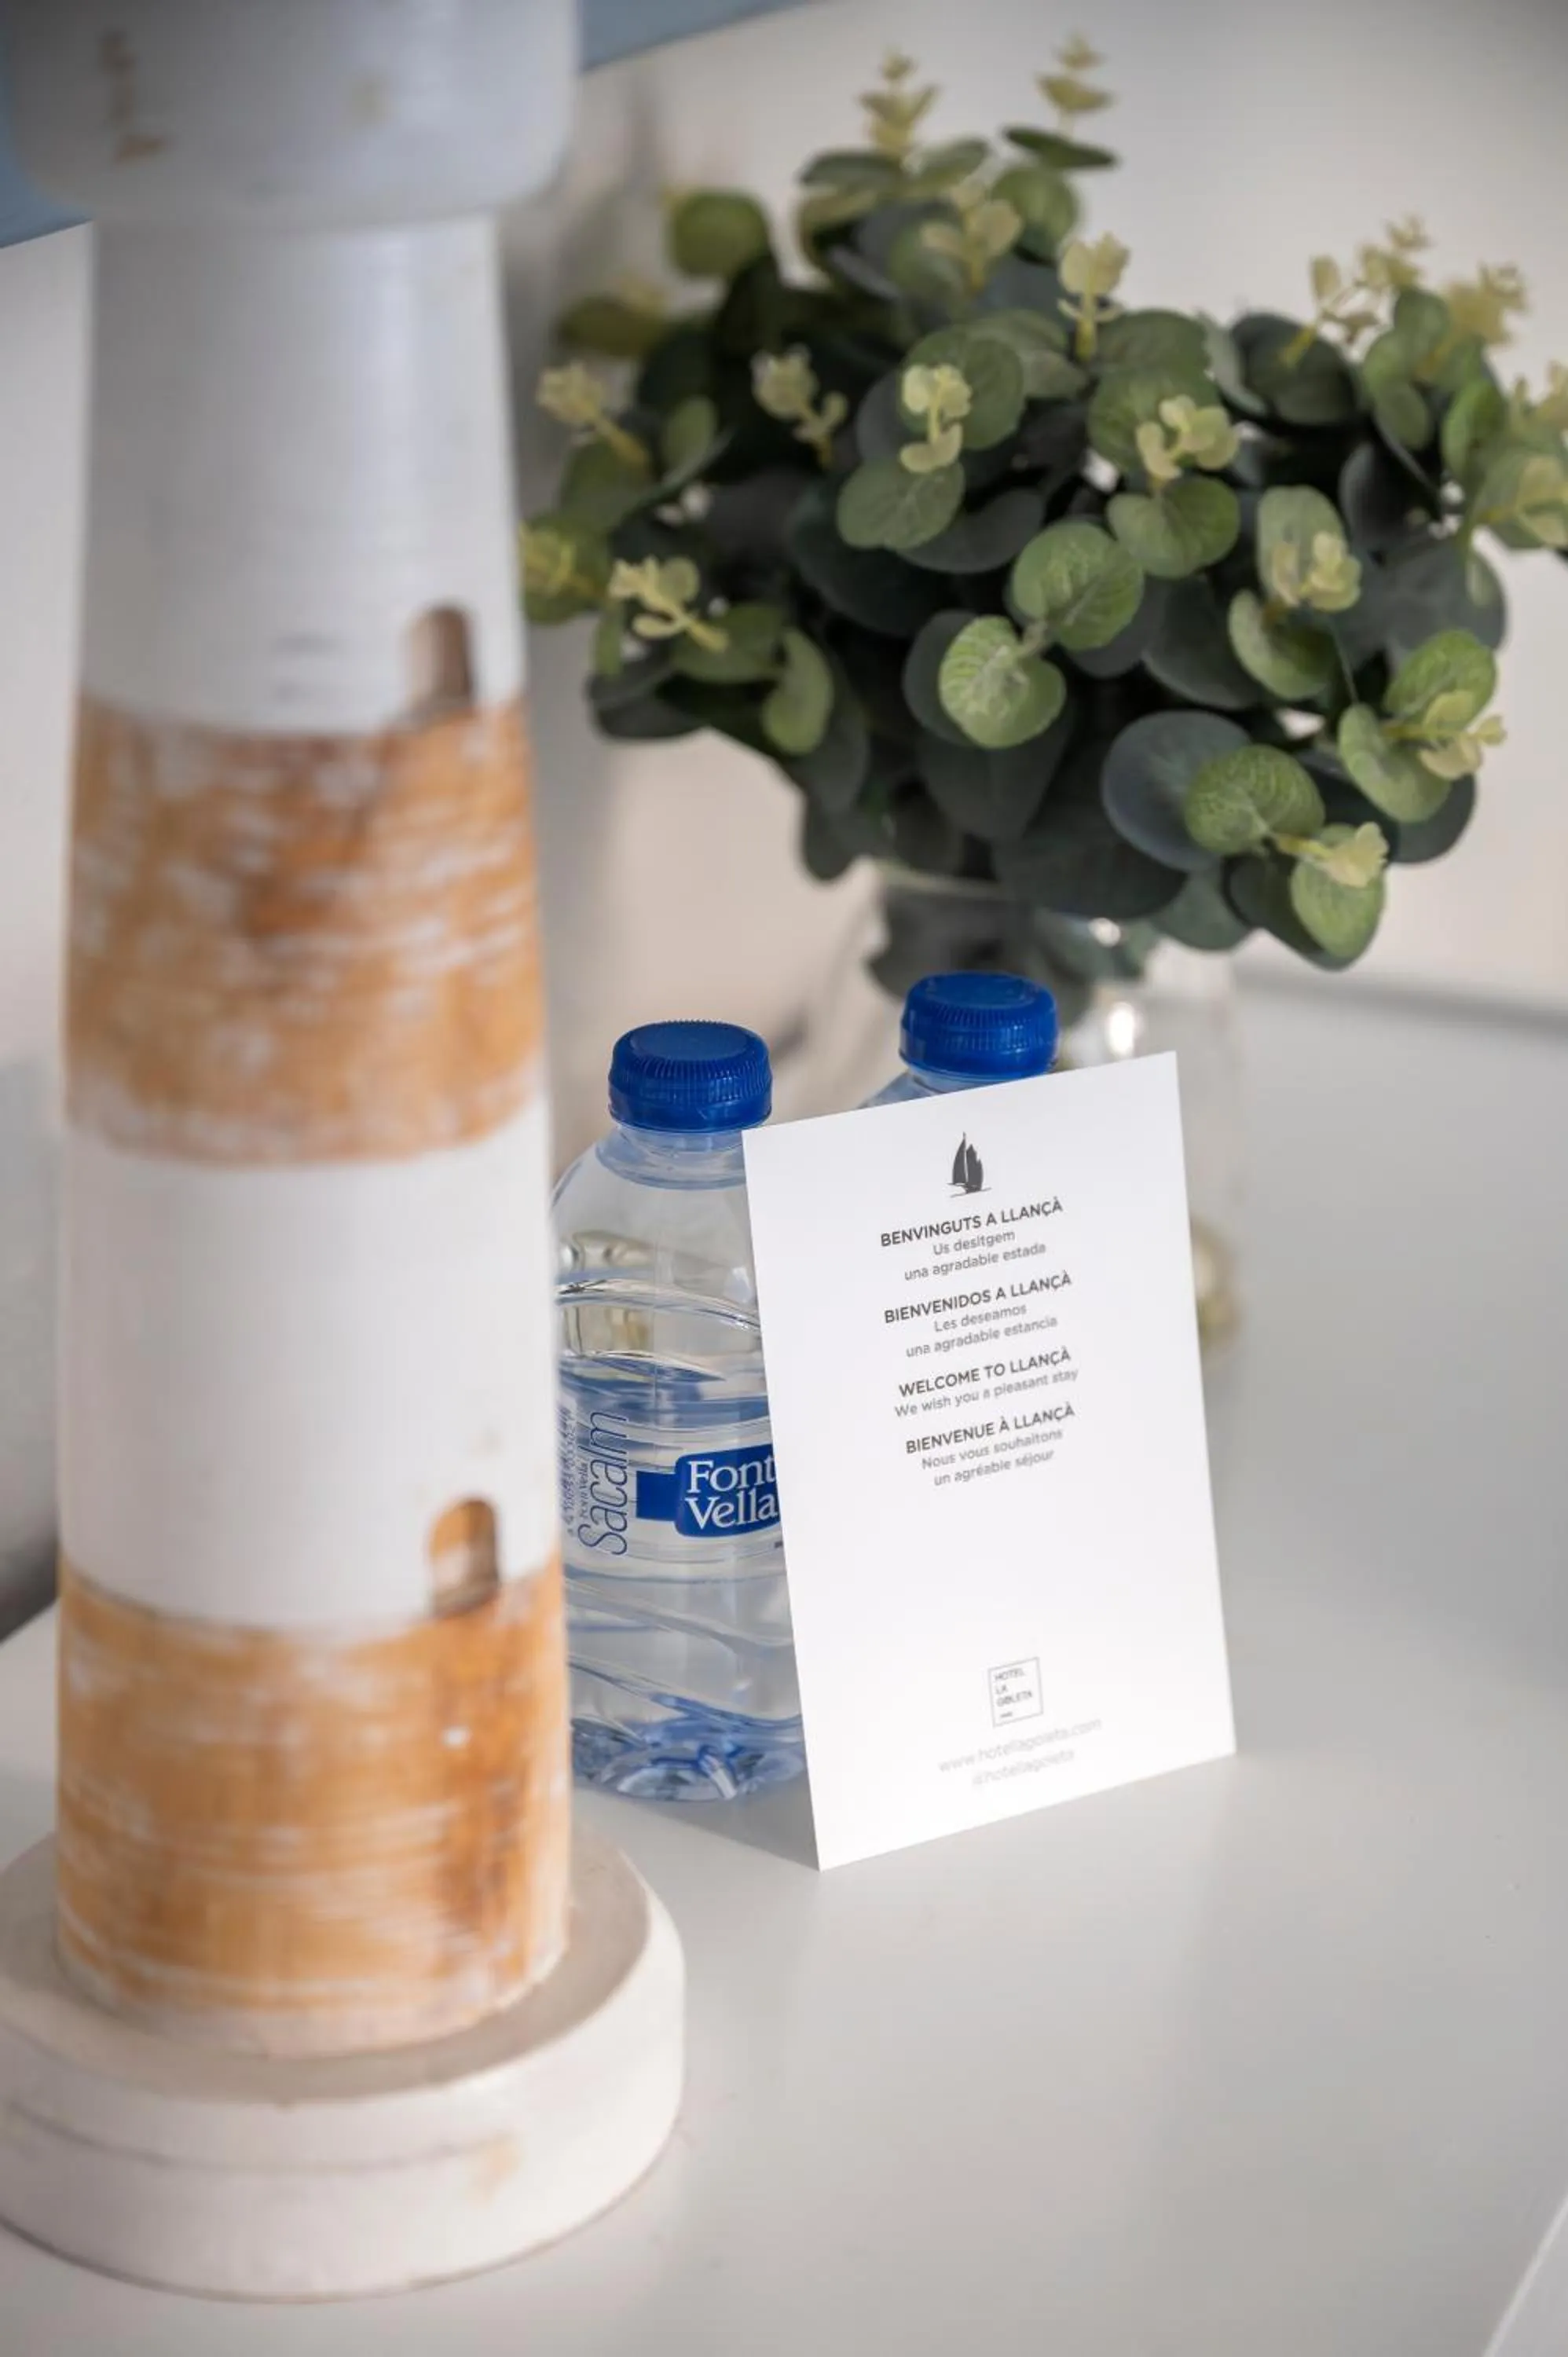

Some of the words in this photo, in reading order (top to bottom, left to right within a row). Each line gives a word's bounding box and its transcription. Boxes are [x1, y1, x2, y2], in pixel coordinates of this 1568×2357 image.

[881, 1215, 981, 1247] BENVINGUTS
[986, 1212, 998, 1227] A
[1001, 1196, 1063, 1224] LLANÇÀ
[932, 1243, 951, 1255] Us
[953, 1230, 1016, 1253] desitgem
[904, 1266, 929, 1281] una
[932, 1251, 999, 1278] agradable
[1002, 1242, 1046, 1262] estada
[884, 1289, 991, 1324] BIENVENIDOS
[995, 1286, 1006, 1301] A
[1010, 1270, 1072, 1297] LLANÇÀ
[934, 1319, 958, 1332] Les
[961, 1304, 1027, 1328] deseamos
[906, 1343, 931, 1358] una
[934, 1328, 1000, 1354] agradable
[1004, 1315, 1058, 1337] estancia
[895, 1403, 918, 1417] We
[921, 1395, 951, 1412] wish
[955, 1391, 980, 1408] you
[983, 1388, 991, 1399] a
[994, 1376, 1049, 1398] pleasant
[1052, 1368, 1079, 1385] stay
[899, 1368, 980, 1397] WELCOME
[984, 1362, 1006, 1380] TO
[1010, 1346, 1072, 1373] LLANÇÀ
[906, 1422, 995, 1454] BIENVENUE
[998, 1415, 1010, 1432] À
[1014, 1402, 1075, 1429] LLANÇÀ
[921, 1453, 956, 1470] Nous
[959, 1446, 991, 1462] vous
[993, 1428, 1063, 1453] souhaitons
[577, 1412, 628, 1556] Sacalm
[686, 1457, 775, 1494] Font
[934, 1473, 951, 1486] un
[954, 1459, 1011, 1482] agréable
[1014, 1450, 1055, 1468] séjour
[685, 1487, 779, 1530] Vella
[994, 1667, 1026, 1681] HOTEL
[995, 1684, 1009, 1695] LA
